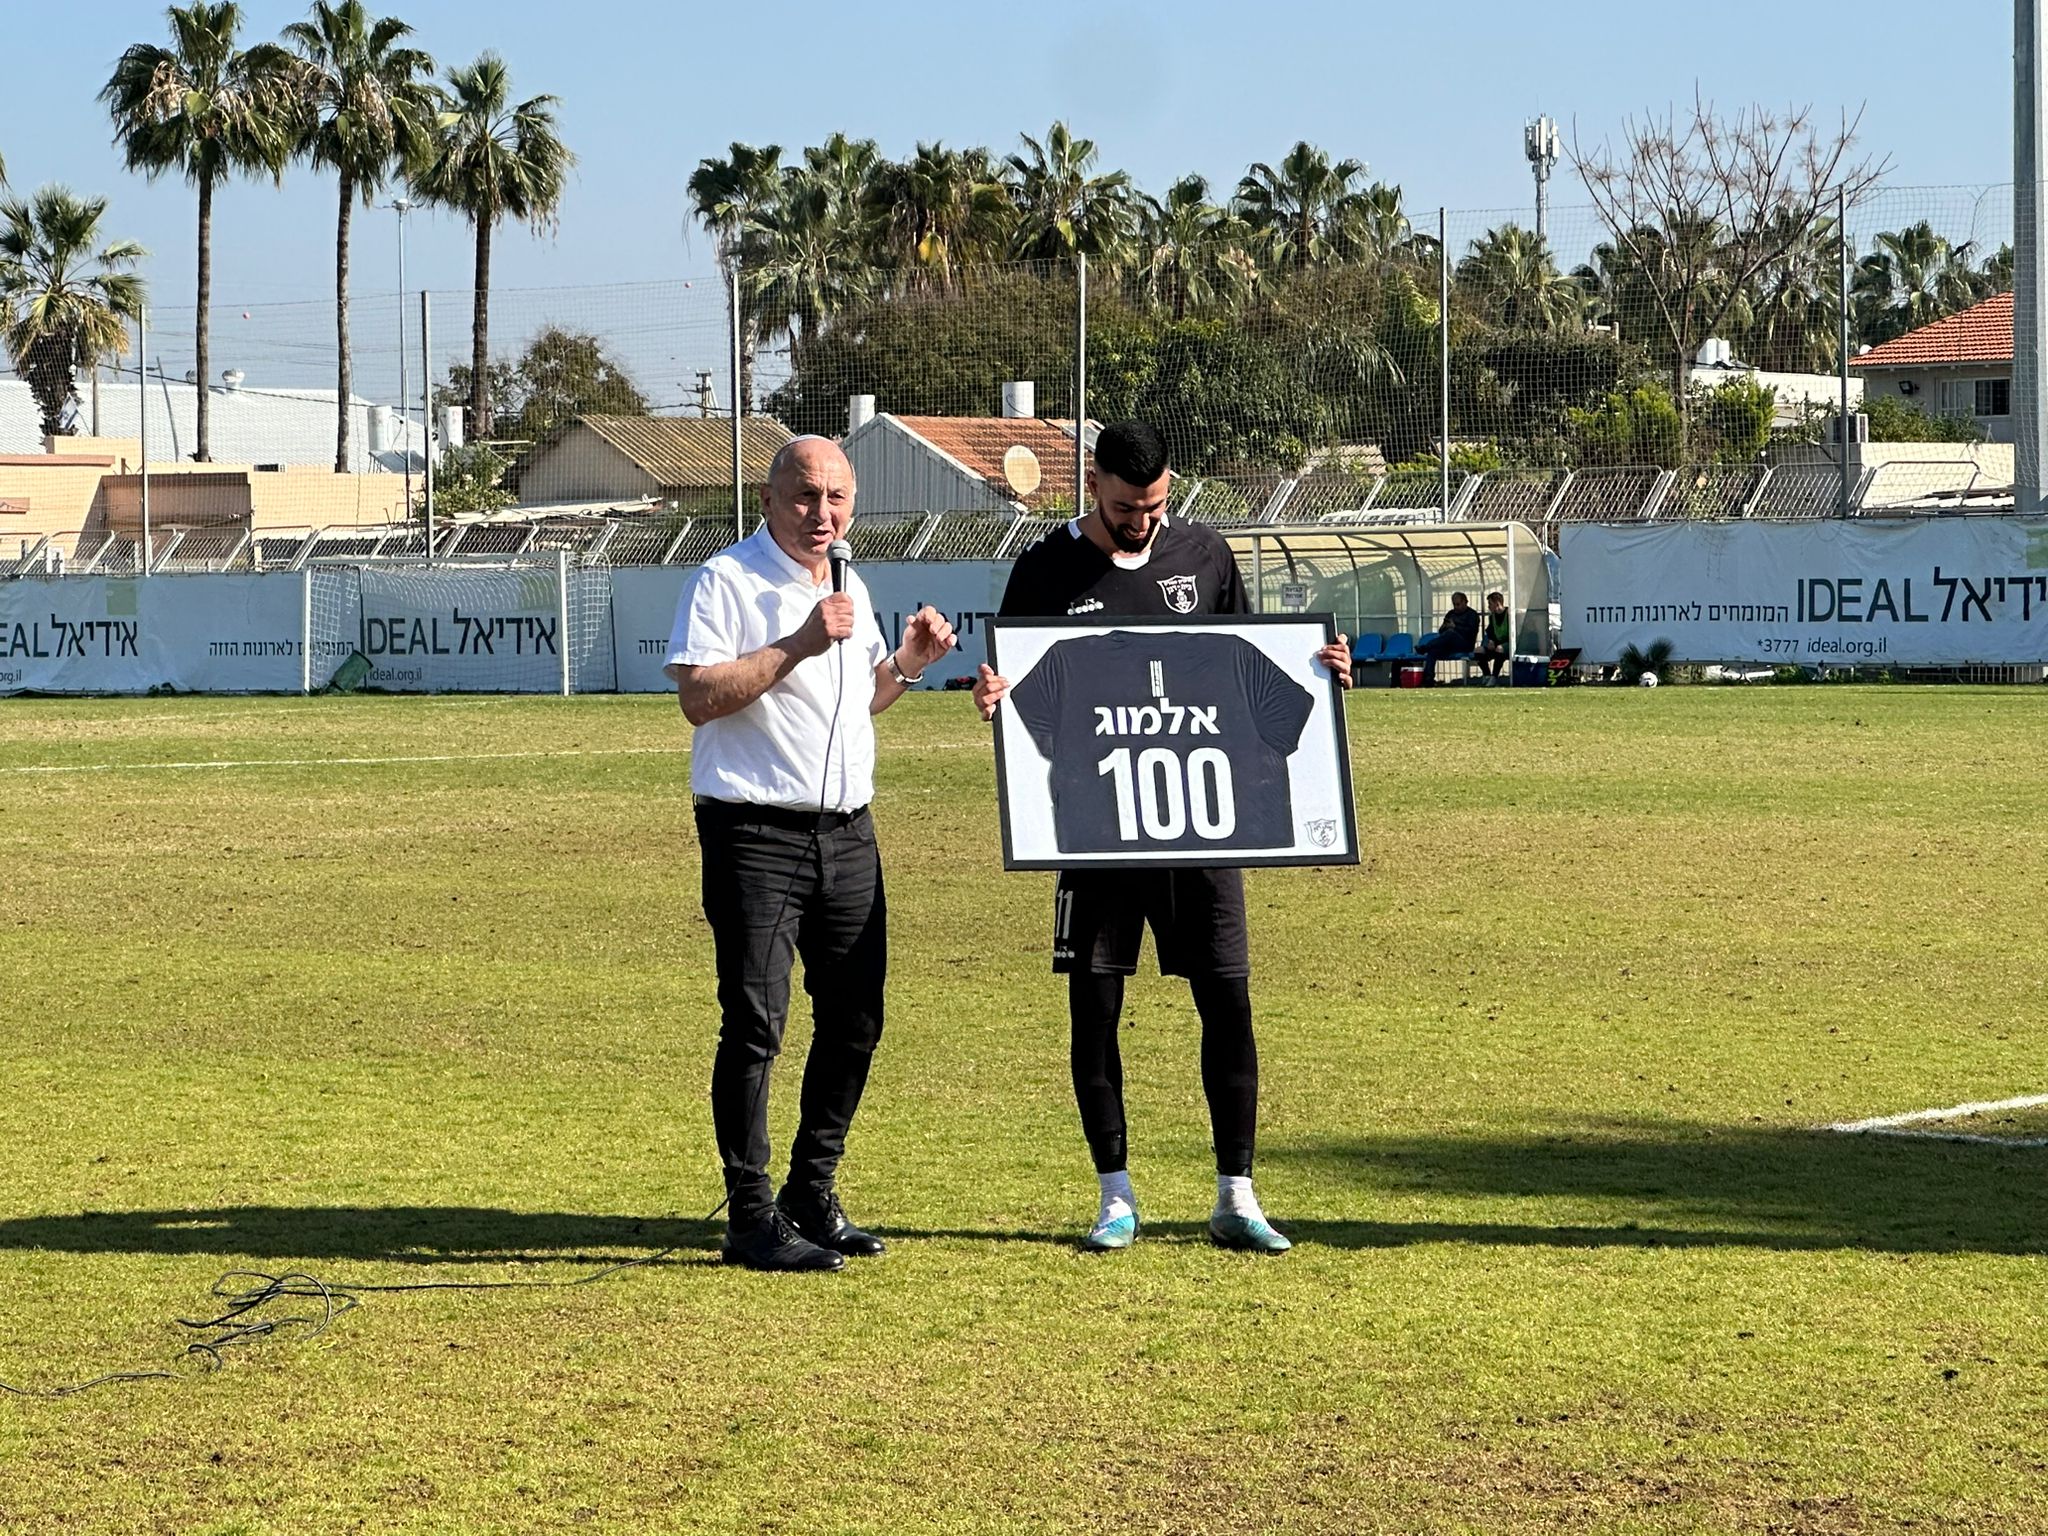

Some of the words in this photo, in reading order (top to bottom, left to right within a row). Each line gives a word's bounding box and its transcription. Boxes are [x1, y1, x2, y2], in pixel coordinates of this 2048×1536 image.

[1586, 605, 1626, 624] הזזה
[1631, 600, 1702, 623] לארונות
[1709, 605, 1789, 623] המומחים
[1797, 578, 1929, 622] IDEAL
[51, 613, 138, 657] אידיאל
[360, 617, 450, 655] IDEAL
[453, 607, 557, 655] אידיאל
[209, 642, 238, 656] הזזה
[243, 638, 293, 656] לארונות
[1807, 636, 1887, 657] ideal.org.il
[369, 667, 422, 684] ideal.org.il
[1094, 697, 1221, 736] אלמוג
[1098, 747, 1236, 841] 100
[1056, 889, 1074, 939] 11
